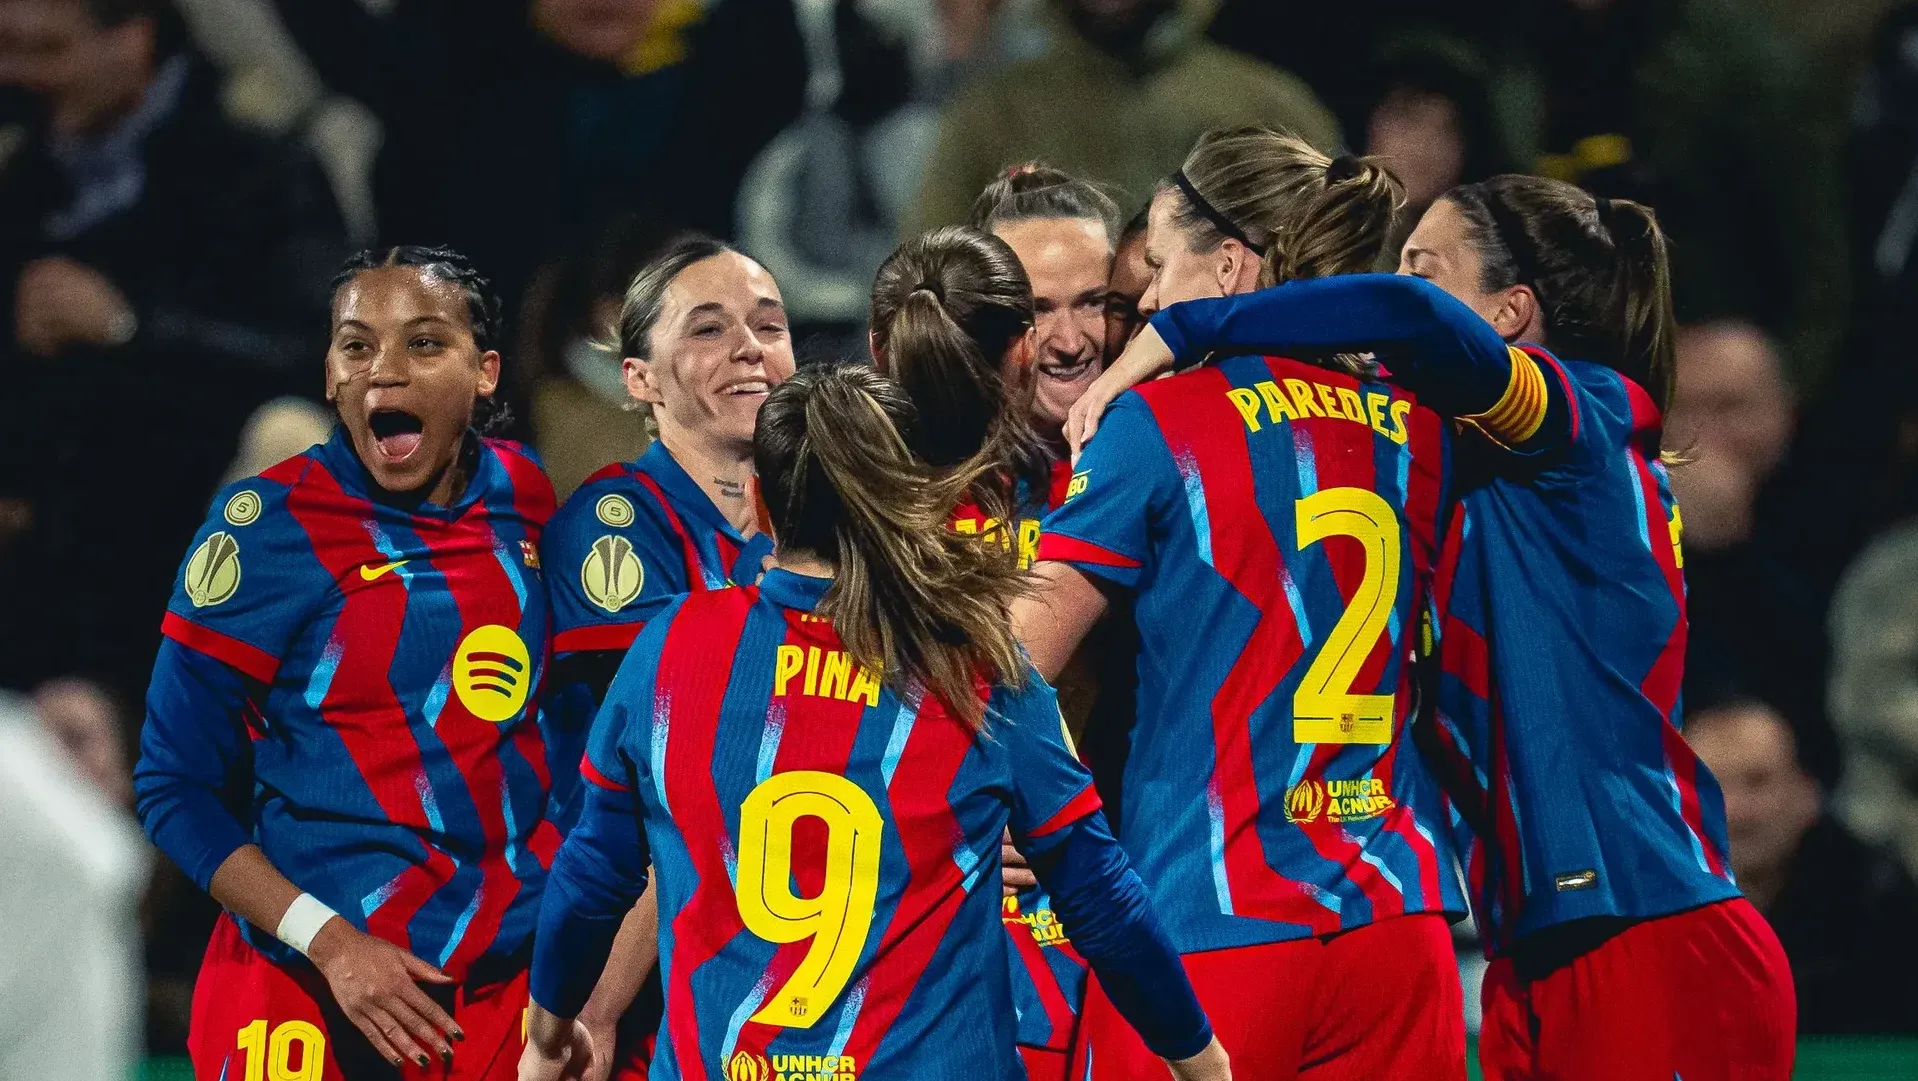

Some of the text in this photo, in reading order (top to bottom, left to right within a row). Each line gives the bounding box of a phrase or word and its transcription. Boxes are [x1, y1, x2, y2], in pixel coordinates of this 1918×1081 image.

[1226, 379, 1411, 445] PAREDES
[235, 501, 250, 514] 5
[610, 506, 621, 517] 5
[1294, 486, 1400, 744] 2
[775, 645, 882, 708] PINA
[1327, 779, 1385, 797] UNHCR
[1326, 796, 1393, 815] ACNUR
[736, 770, 884, 1029] 9
[772, 1055, 856, 1072] UNHCR
